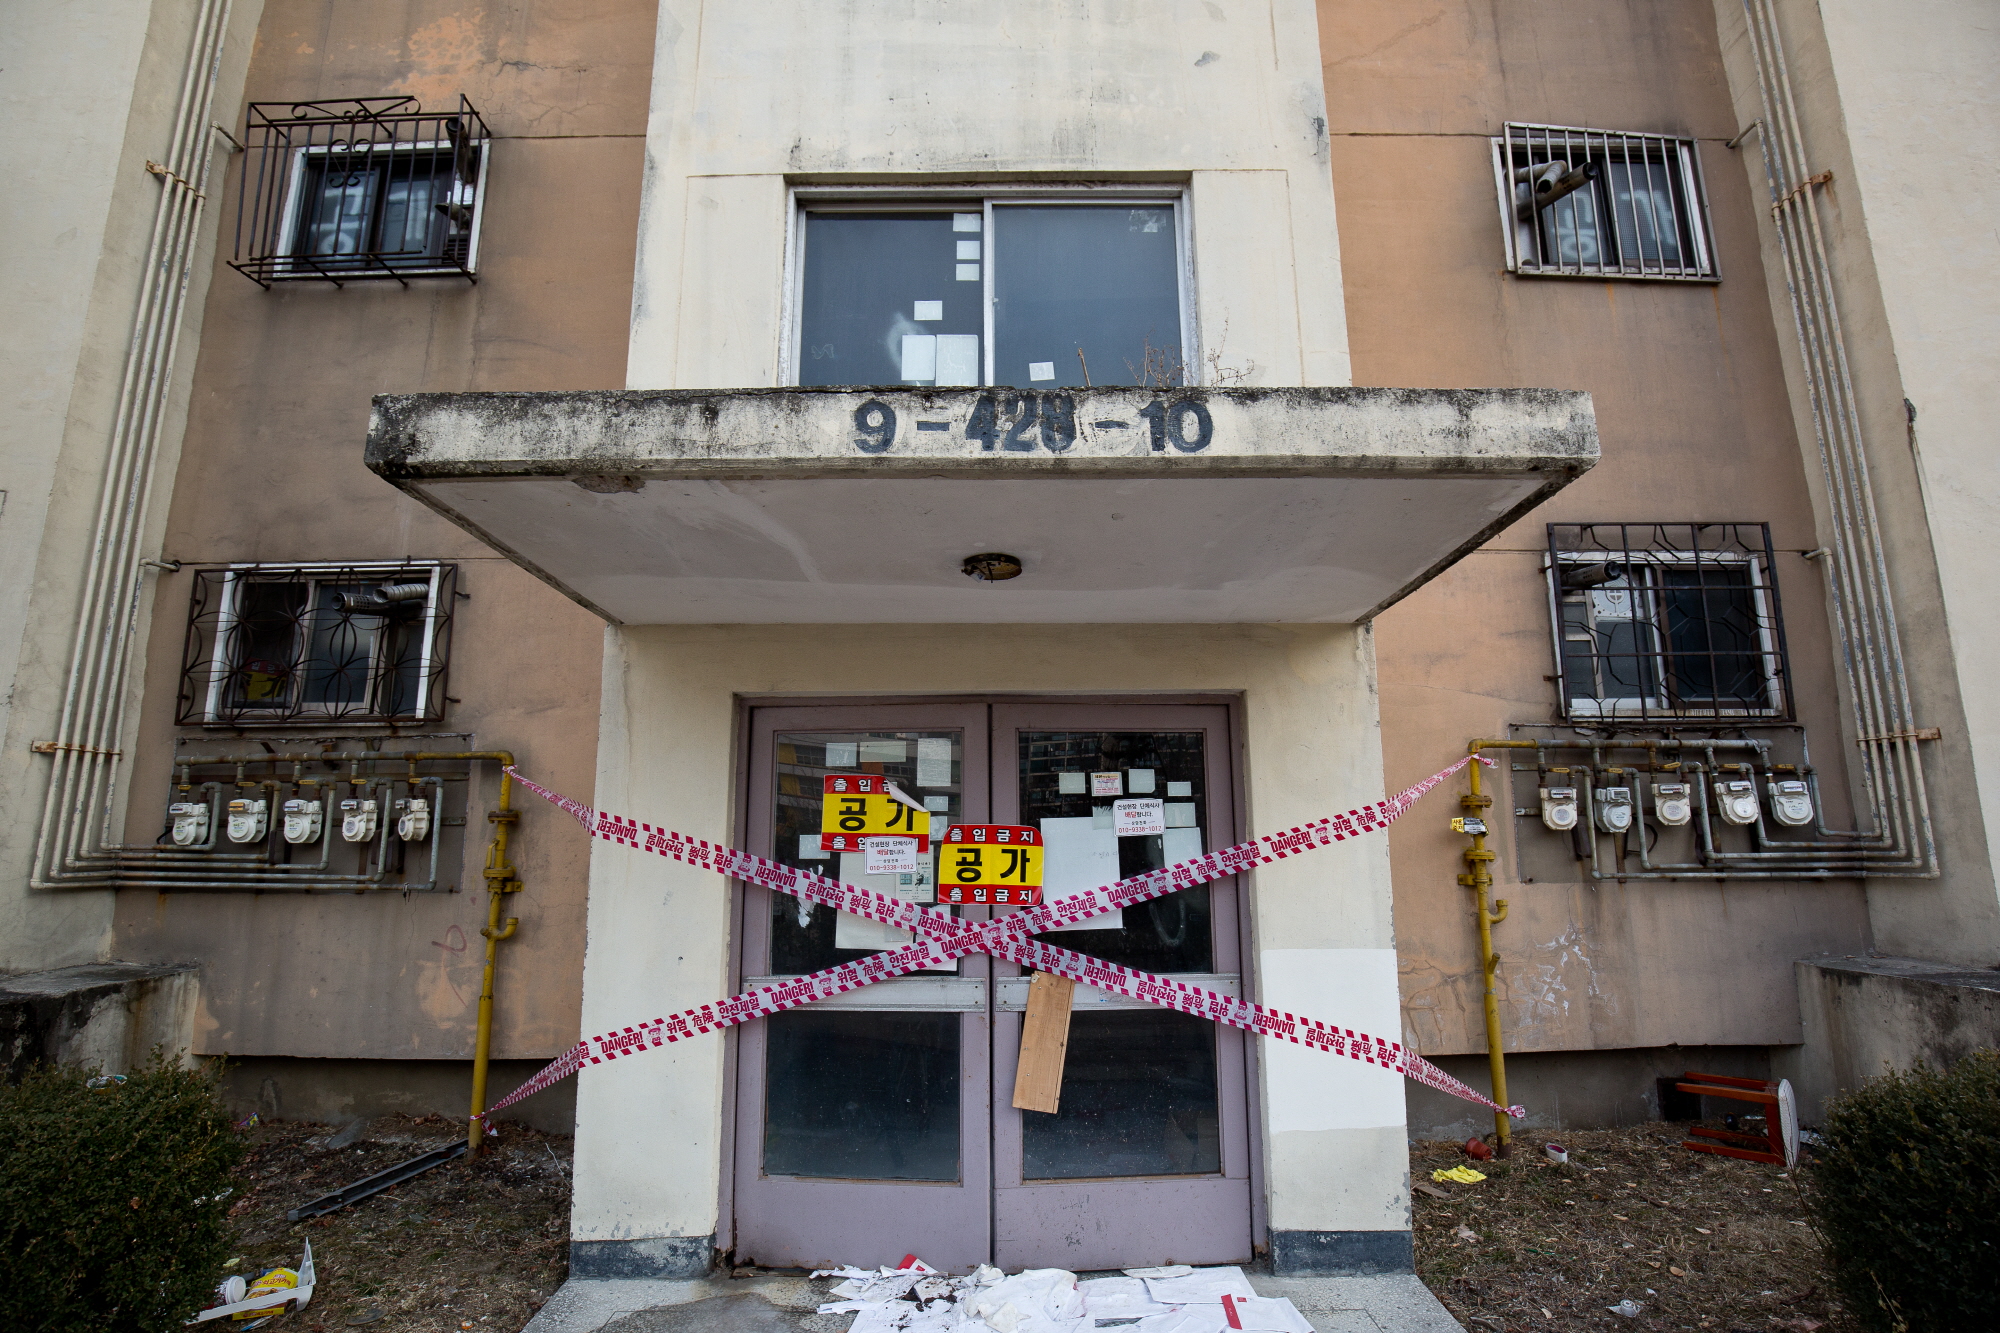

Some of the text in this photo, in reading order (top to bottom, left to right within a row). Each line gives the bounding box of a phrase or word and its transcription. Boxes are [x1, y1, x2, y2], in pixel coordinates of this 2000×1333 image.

[838, 797, 917, 831] 공가
[596, 819, 638, 841] DANGER!
[949, 828, 1034, 844] 출입금지
[646, 833, 685, 854] 안전제일
[688, 846, 710, 861] 危險
[713, 853, 733, 869] 위험
[955, 847, 1031, 883] 공가
[754, 866, 798, 887] DANGER!
[806, 882, 846, 903] 안전제일
[949, 887, 1032, 903] 출입금지
[849, 895, 872, 910] 危險
[875, 902, 896, 918] 위험
[600, 1031, 644, 1053] DANGER!
[666, 1019, 688, 1034] 위험
[691, 1011, 714, 1027] 危險
[719, 997, 760, 1019] 안전제일
[770, 981, 815, 1004] DANGER!
[837, 968, 858, 983] 위험
[863, 961, 886, 976] 危險
[890, 947, 931, 968] 안전제일
[940, 931, 984, 953] DANGER!
[1006, 917, 1027, 933] 위험
[1030, 909, 1053, 926] 危險
[1057, 895, 1097, 918] 안전제일
[1107, 881, 1150, 903] DANGER!
[1171, 868, 1192, 882] 위험
[1196, 860, 1218, 875] 危險
[1221, 846, 1261, 867] 안전제일
[1270, 831, 1312, 853] DANGER!
[1332, 818, 1353, 833] 위험
[1355, 810, 1377, 827] 危險
[1014, 944, 1036, 960] 危險
[1040, 952, 1060, 968] 위험
[1083, 965, 1127, 987] DANGER!
[1136, 979, 1177, 1002] 안전제일
[1182, 992, 1204, 1009] 危險
[1208, 1001, 1229, 1017] 위험
[1252, 1013, 1296, 1035] DANGER!
[1306, 1027, 1345, 1049] 안전제일
[1350, 1040, 1372, 1055] 危險
[1377, 1048, 1397, 1063] 위험
